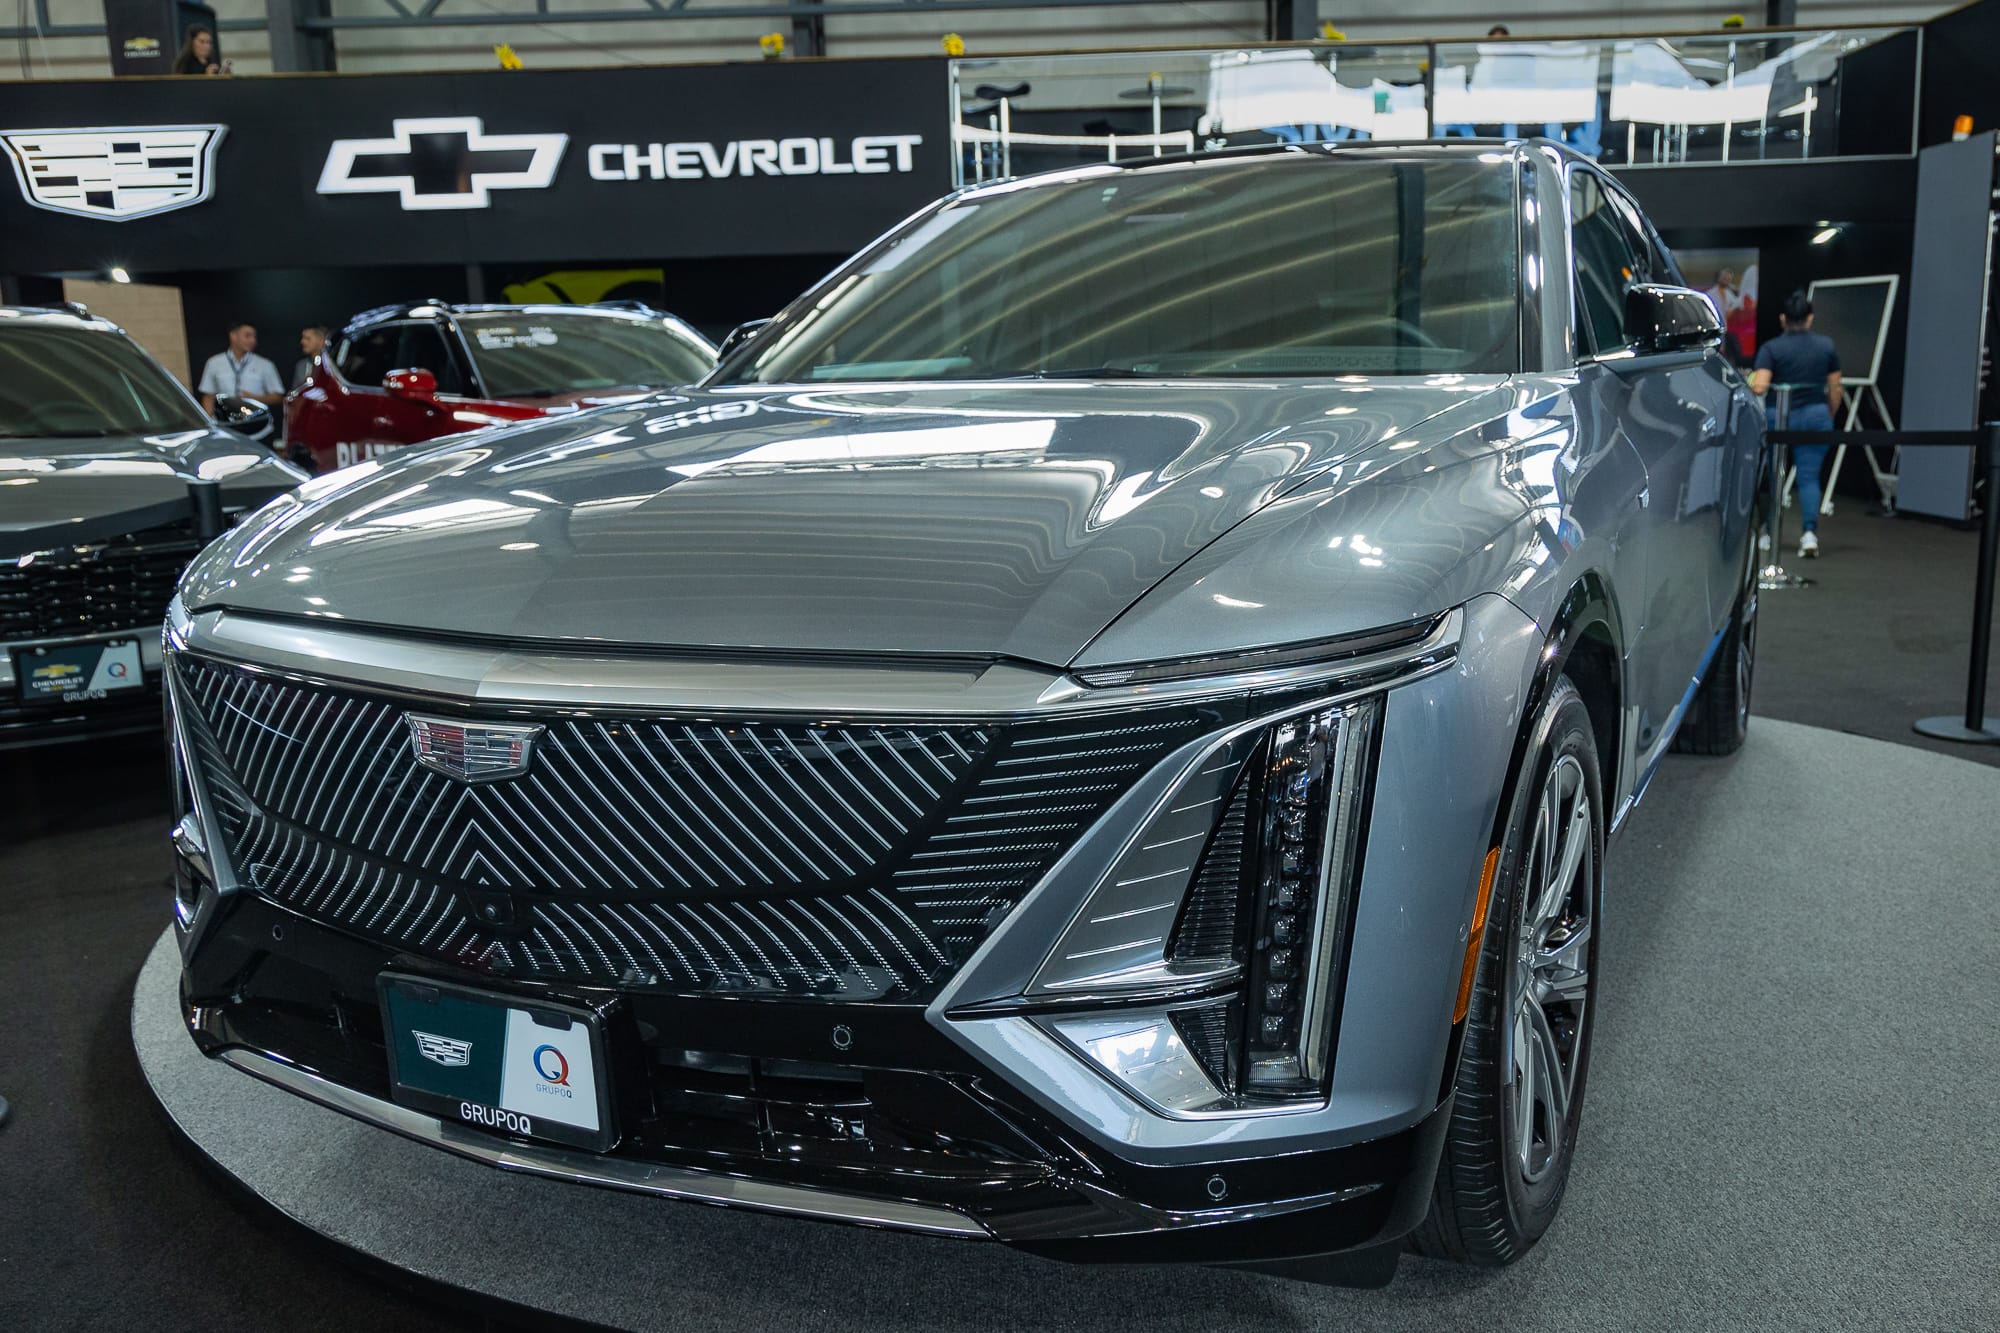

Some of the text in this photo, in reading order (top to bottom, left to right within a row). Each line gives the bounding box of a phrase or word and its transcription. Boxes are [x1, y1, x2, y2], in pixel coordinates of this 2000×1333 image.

[588, 135, 922, 181] CHEVROLET
[533, 1044, 571, 1087] Q
[536, 1084, 572, 1099] GRUPOQ
[460, 1102, 532, 1135] GRUPOQ
